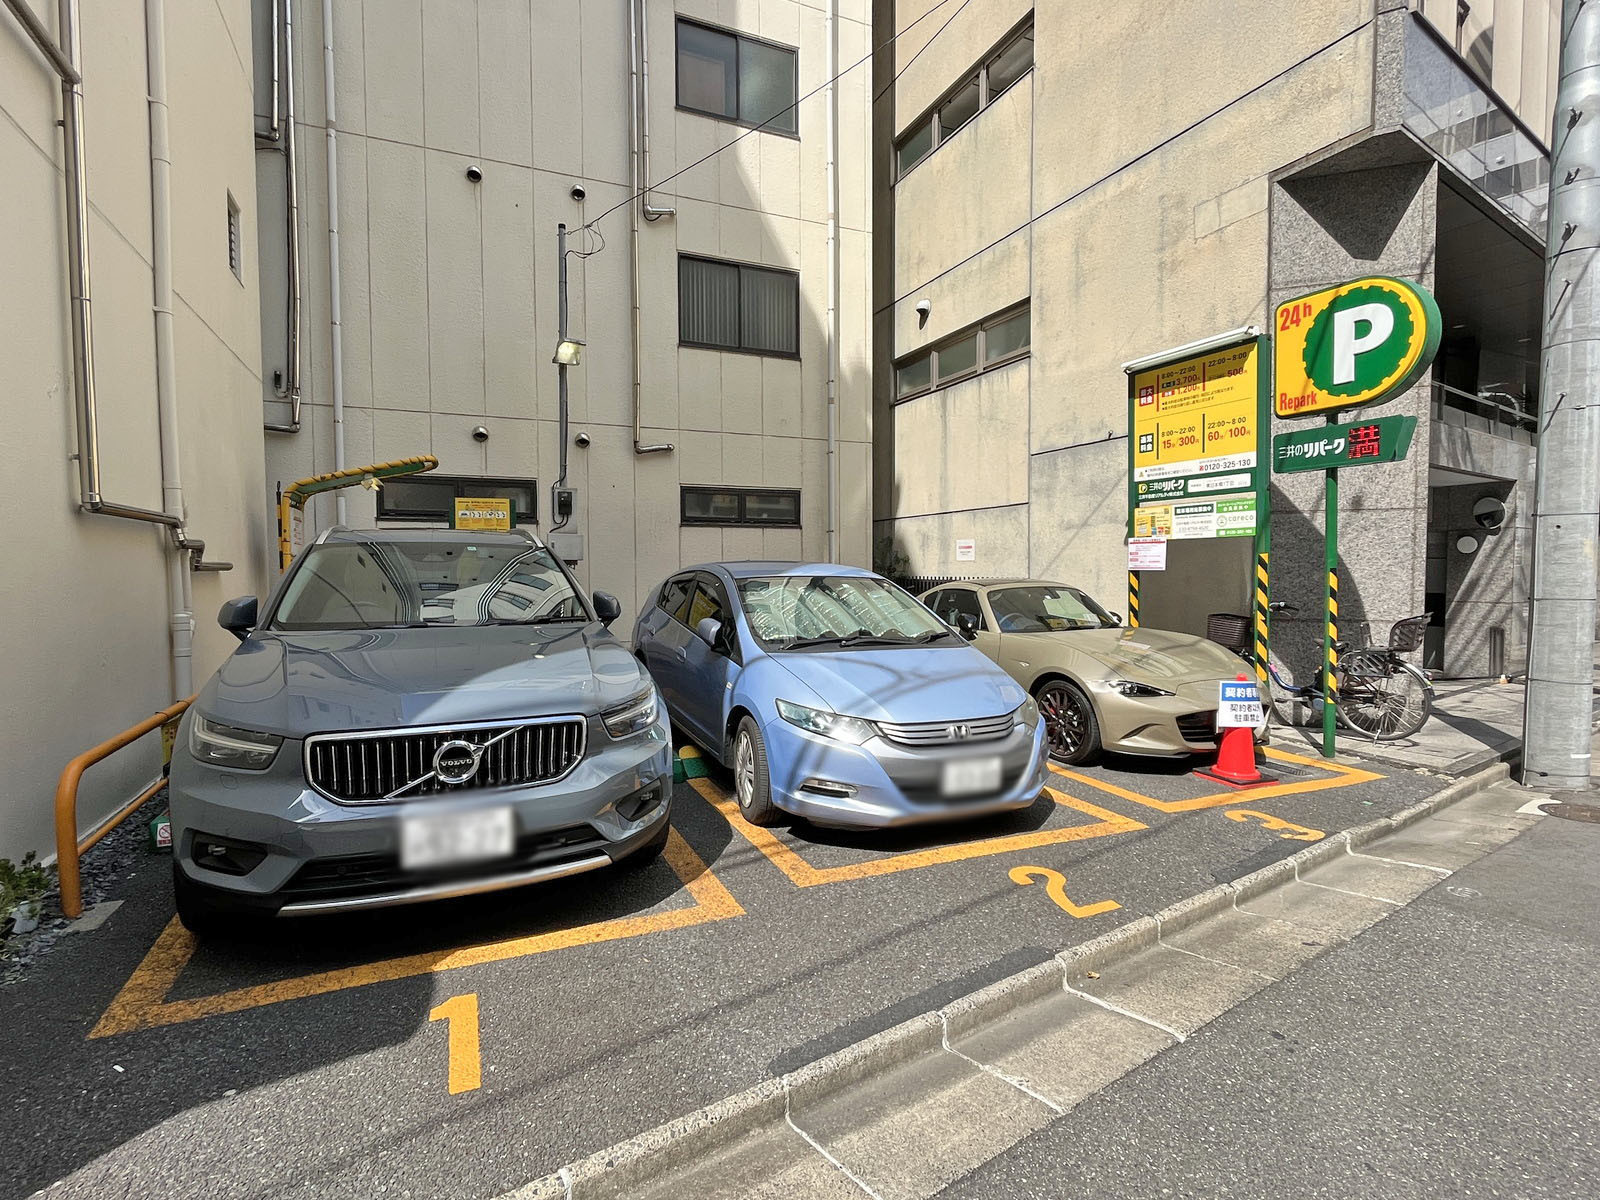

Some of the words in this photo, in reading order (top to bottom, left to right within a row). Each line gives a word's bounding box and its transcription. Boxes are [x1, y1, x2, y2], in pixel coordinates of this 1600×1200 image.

[1280, 302, 1312, 332] 24h
[1333, 302, 1394, 385] P
[1280, 391, 1317, 411] Repark
[1278, 437, 1345, 459] 三井のリパーク
[1204, 458, 1251, 471] 0120-325-130
[440, 759, 472, 767] VOLVO
[1224, 809, 1327, 842] 3
[1008, 865, 1122, 919] 2
[429, 993, 482, 1096] 1
